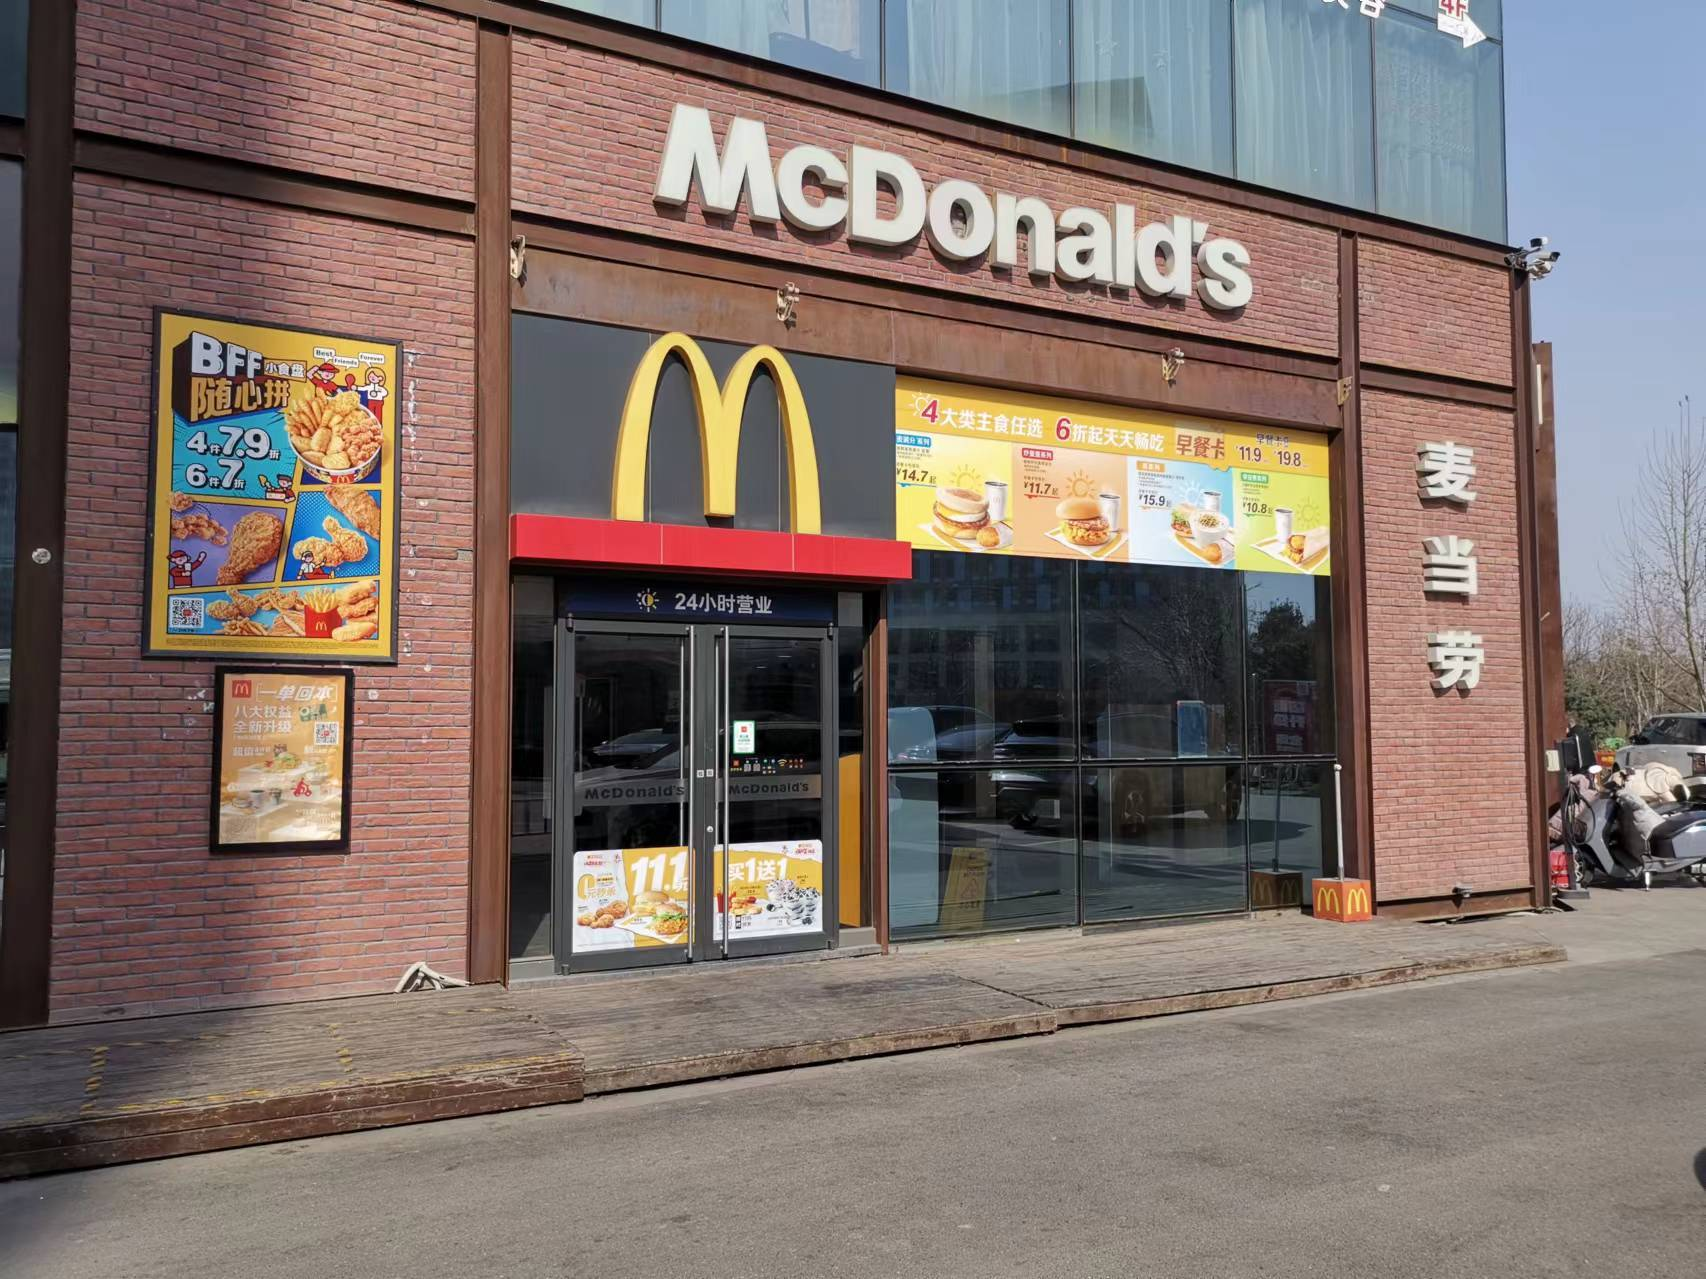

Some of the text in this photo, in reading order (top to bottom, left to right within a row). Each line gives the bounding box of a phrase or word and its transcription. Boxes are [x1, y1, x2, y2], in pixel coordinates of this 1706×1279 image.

[654, 102, 1253, 310] McDonald's
[192, 332, 262, 378] BFF
[191, 376, 289, 422] 随心拼
[1416, 441, 1485, 690] 麦当劳
[675, 593, 773, 615] 24小时营业
[234, 705, 293, 719] 八大权益
[584, 786, 686, 800] McDonald's
[728, 782, 809, 796] McDonald's
